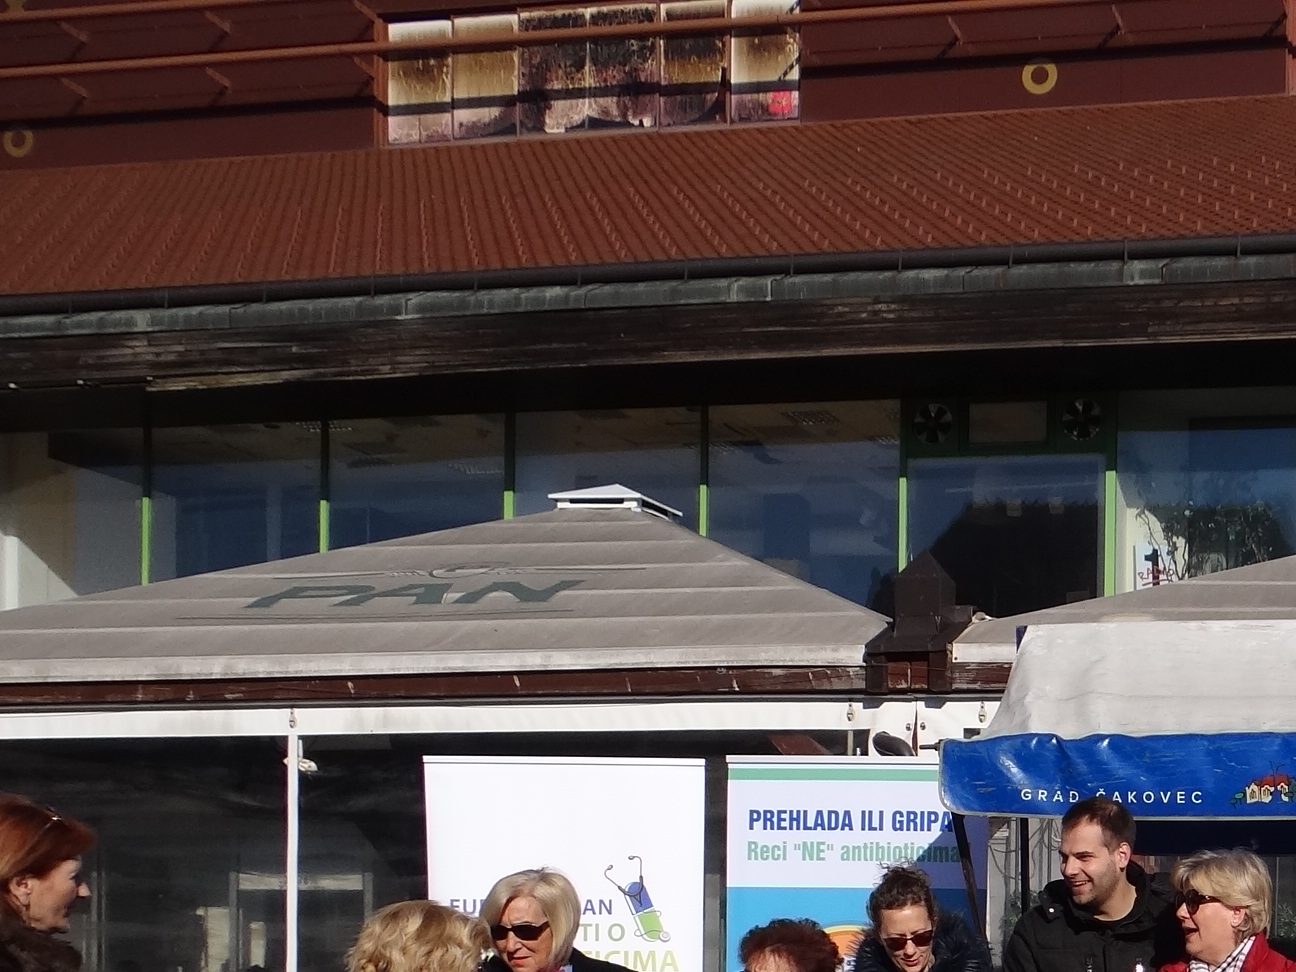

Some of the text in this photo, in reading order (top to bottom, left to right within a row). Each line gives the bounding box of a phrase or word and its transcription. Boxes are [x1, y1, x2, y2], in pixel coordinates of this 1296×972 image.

[243, 579, 585, 609] PAN
[1021, 788, 1203, 804] GRAD ČAKOVEC
[748, 809, 954, 832] PREHLADA ILI GRIPA
[747, 841, 787, 861] Reci
[793, 841, 834, 862] "NE"
[449, 898, 613, 916] EU AN
[607, 923, 626, 942] O
